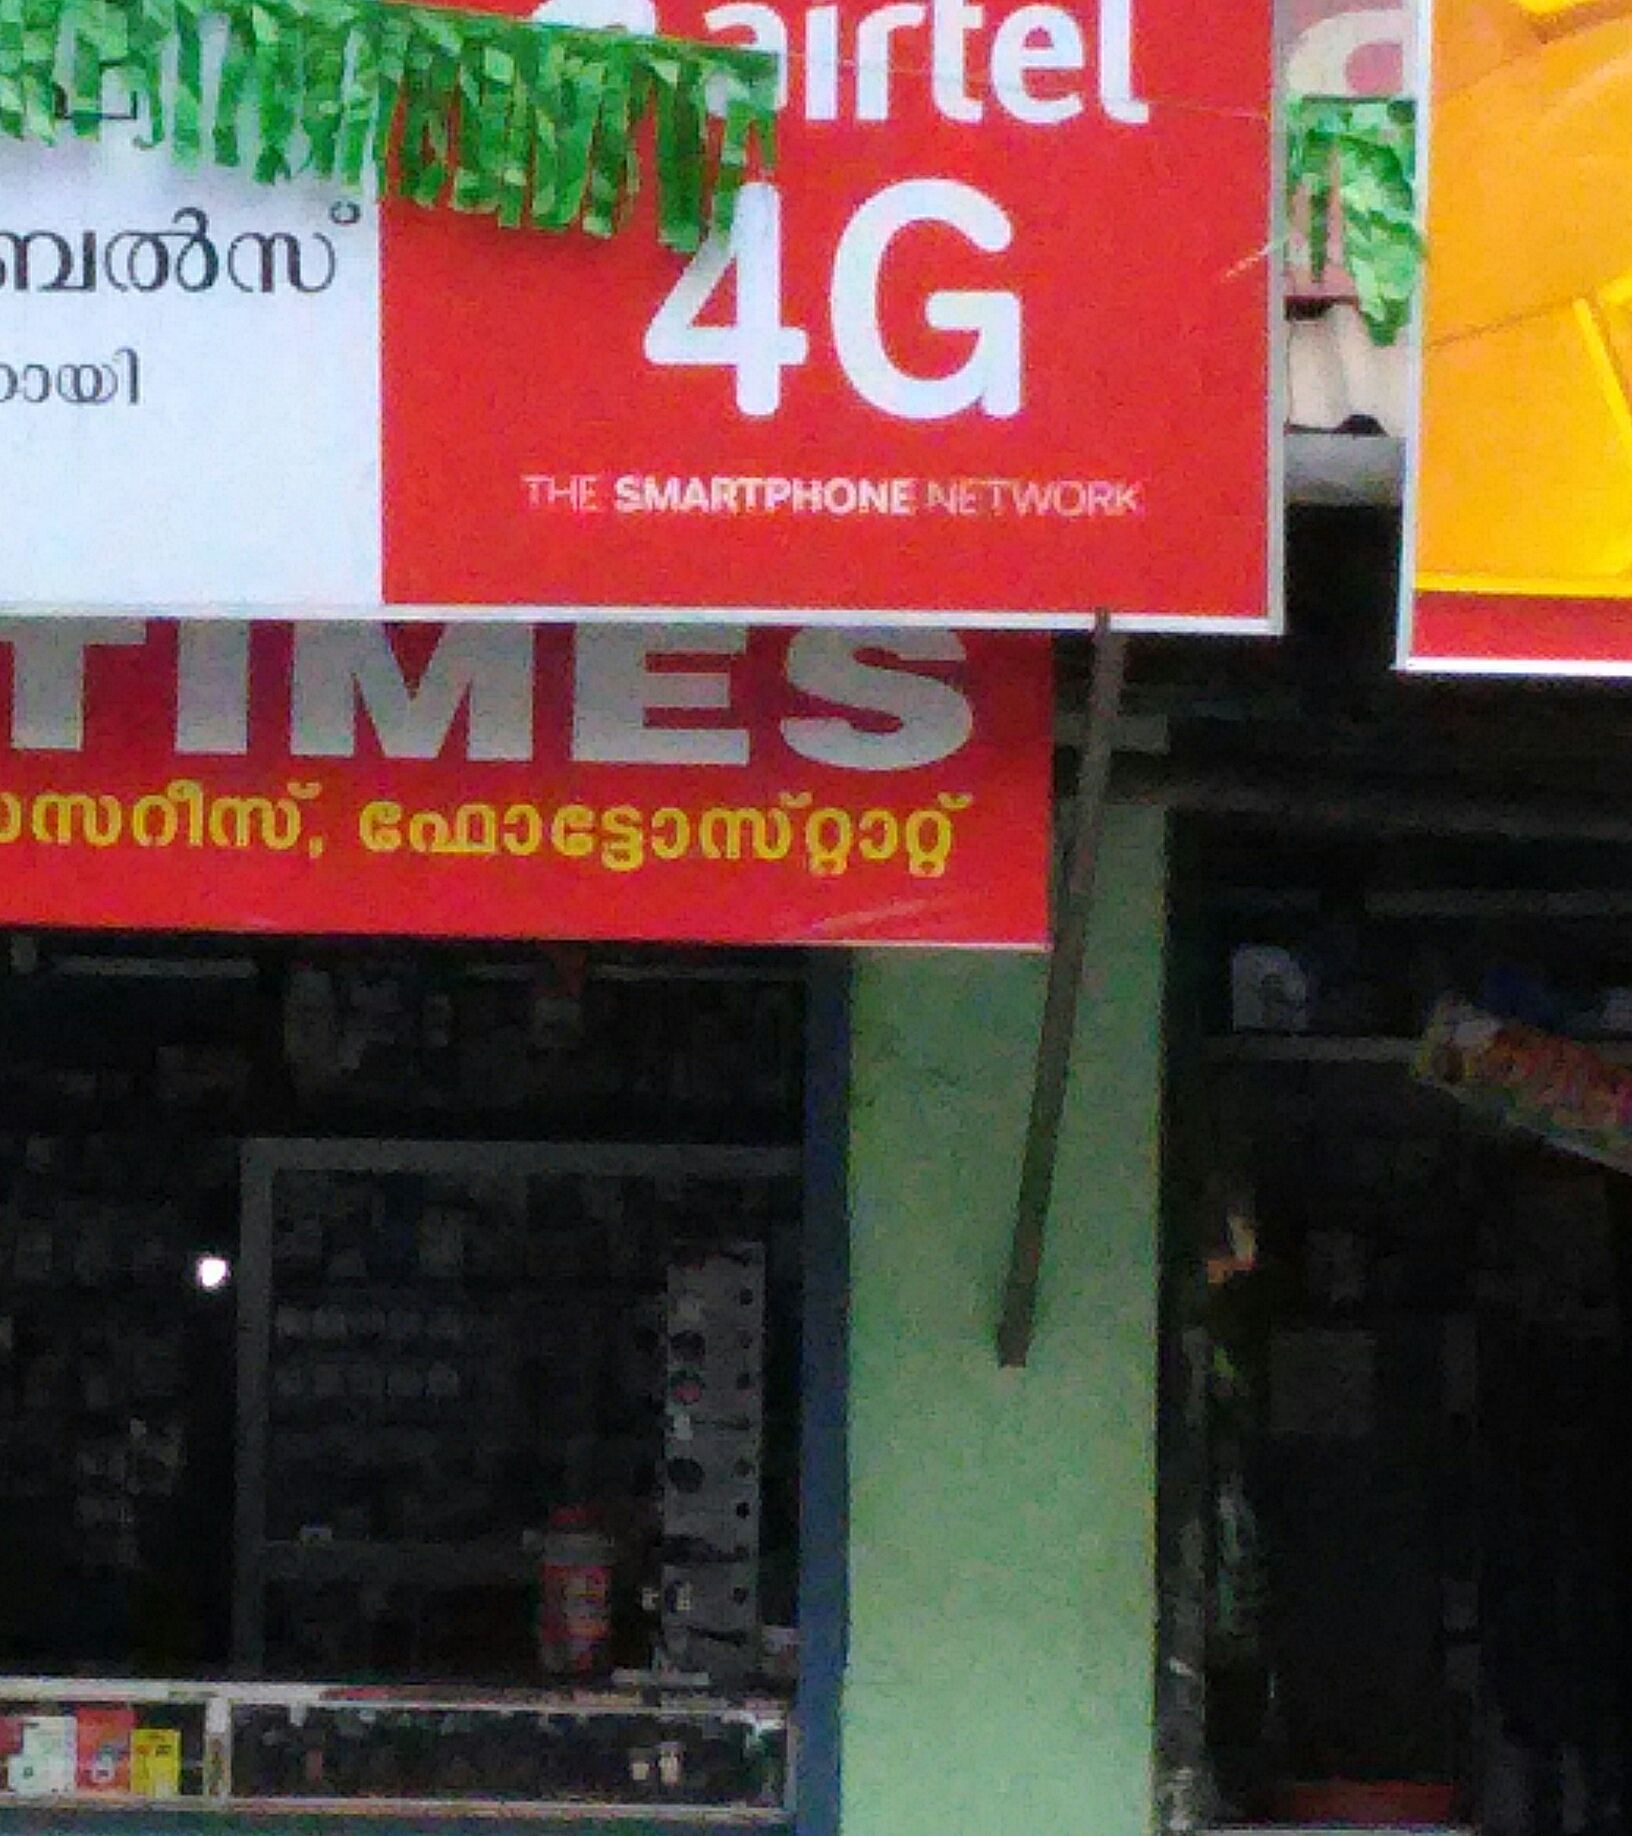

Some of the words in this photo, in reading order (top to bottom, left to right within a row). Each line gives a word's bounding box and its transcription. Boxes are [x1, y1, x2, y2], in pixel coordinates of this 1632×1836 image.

[644, 178, 1021, 421] 4G
[522, 475, 601, 514] THE
[614, 475, 916, 515] SMARTPHONE
[924, 478, 1145, 517] NETWORK
